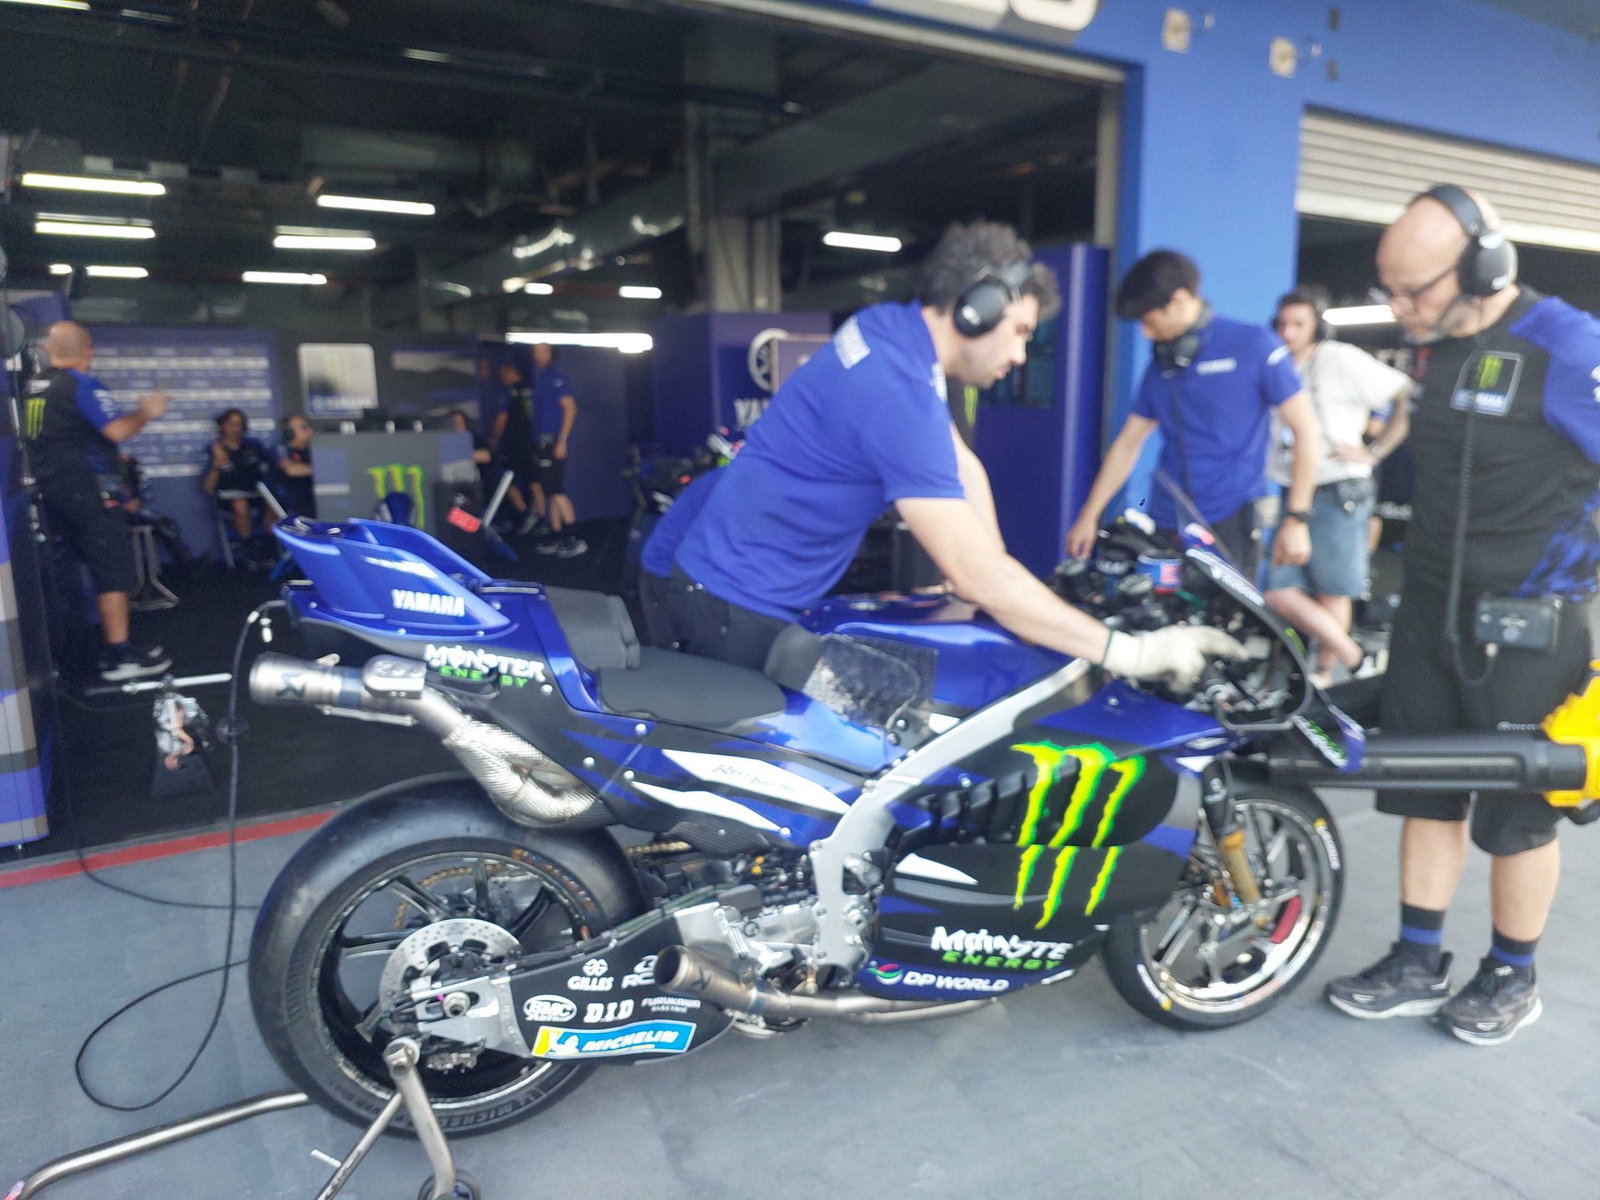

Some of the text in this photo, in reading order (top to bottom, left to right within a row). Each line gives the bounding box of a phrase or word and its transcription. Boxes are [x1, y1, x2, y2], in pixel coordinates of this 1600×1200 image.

[391, 588, 465, 617] YAMAHA
[424, 643, 546, 682] MONSTER
[438, 665, 529, 688] ENEGY
[931, 926, 1073, 959] MONSTE
[942, 949, 1062, 970] ENERGY
[620, 972, 656, 990] RC
[902, 971, 1010, 992] DP WORLD
[580, 1030, 680, 1052] MICHELIN
